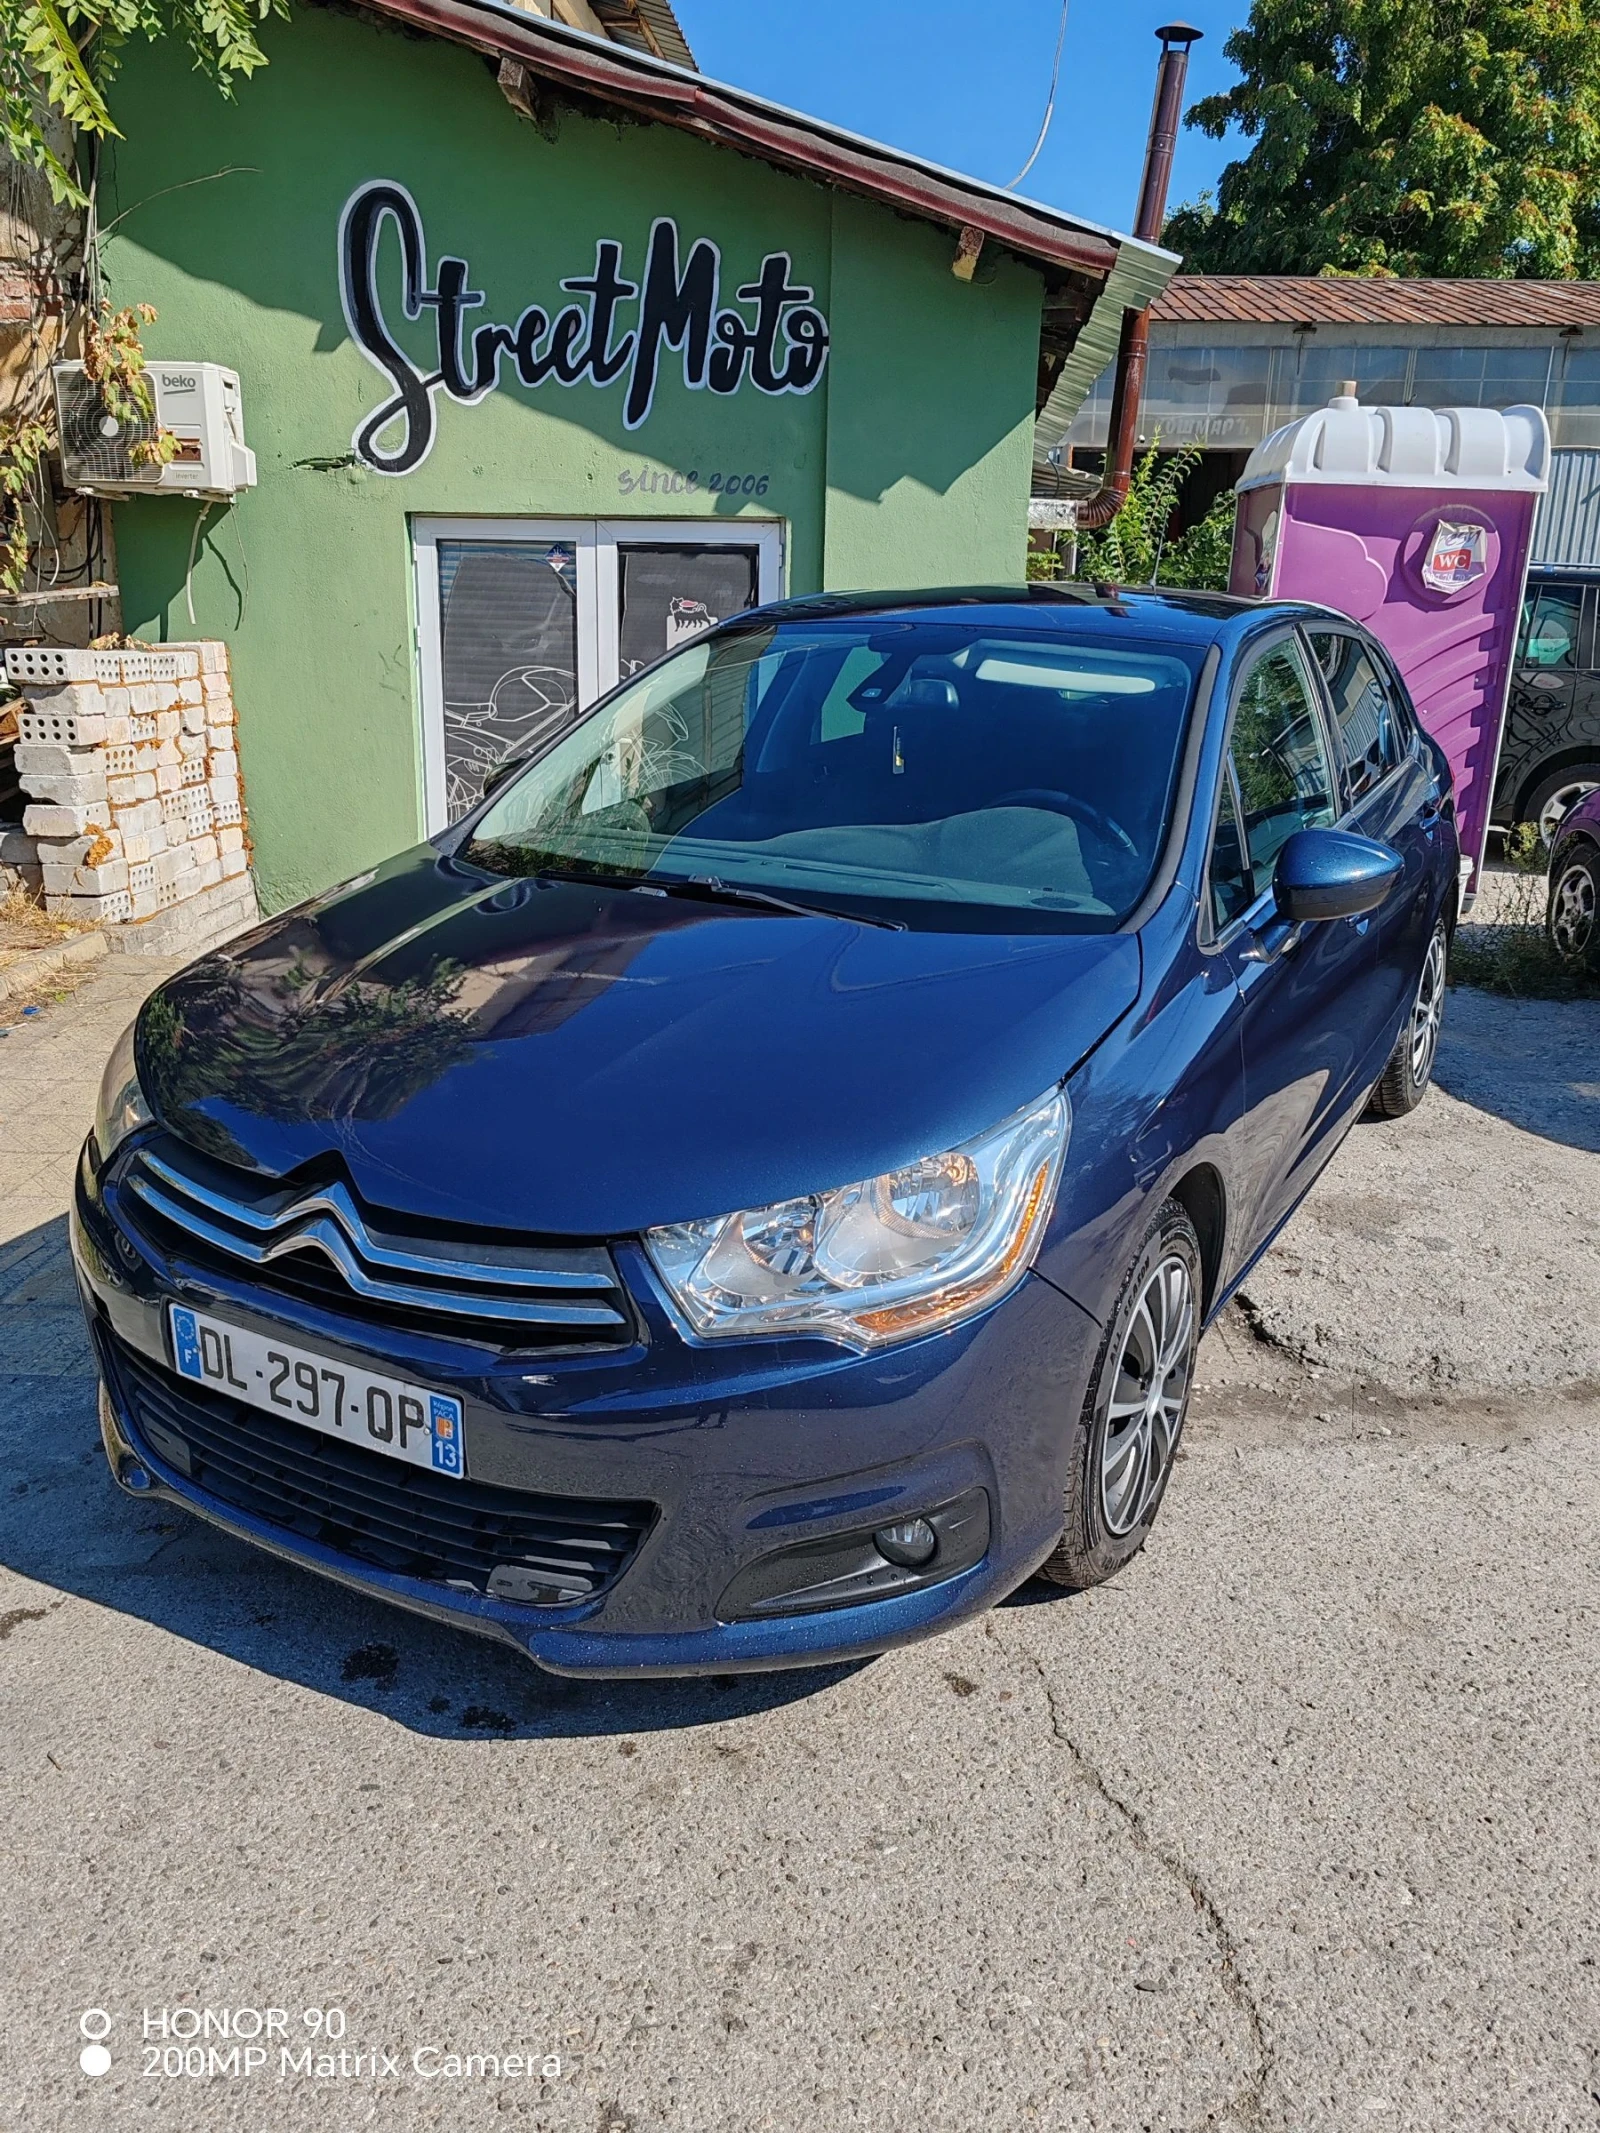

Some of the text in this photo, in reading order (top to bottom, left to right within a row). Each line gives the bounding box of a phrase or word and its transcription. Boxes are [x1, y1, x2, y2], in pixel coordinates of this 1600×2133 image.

[162, 374, 196, 388] beko
[618, 465, 769, 496] since 2006
[1438, 554, 1467, 568] WC
[184, 1347, 193, 1364] F
[433, 1408, 455, 1421] PACA
[435, 1440, 457, 1468] 13
